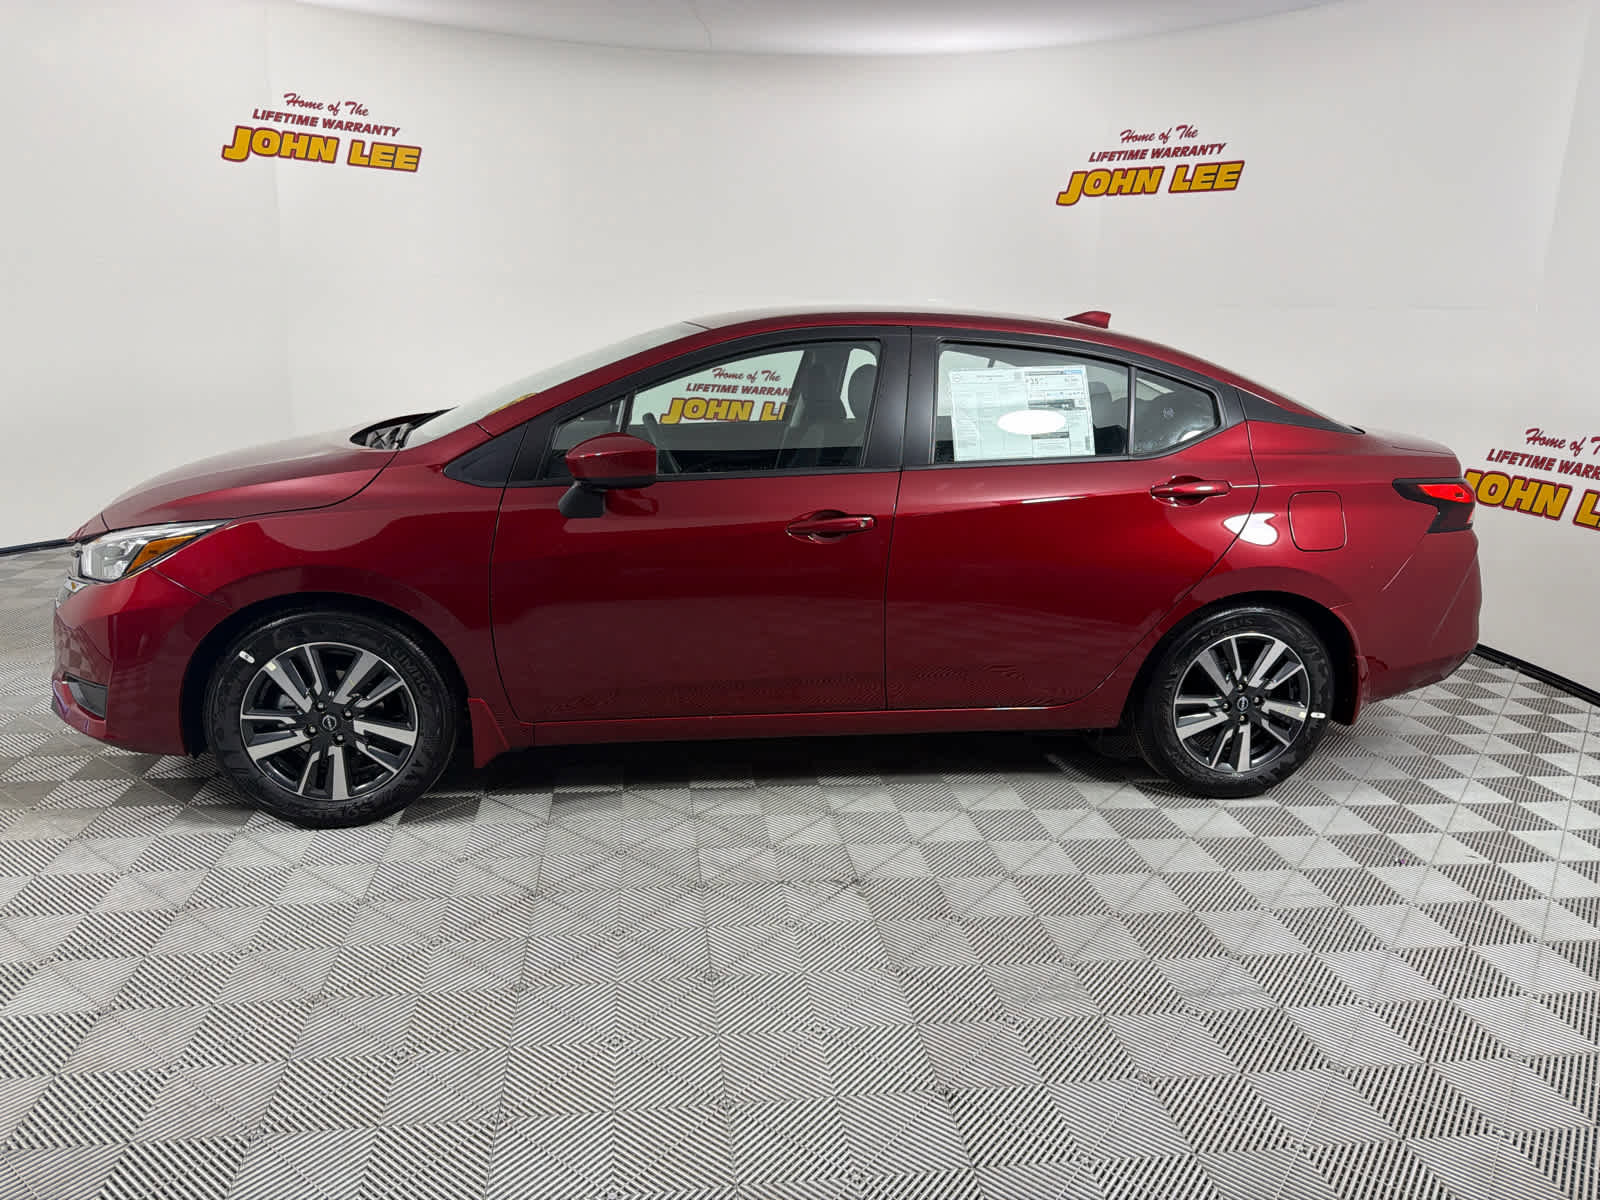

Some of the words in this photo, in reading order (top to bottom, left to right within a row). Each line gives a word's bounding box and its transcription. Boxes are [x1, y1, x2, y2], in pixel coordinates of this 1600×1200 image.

[283, 93, 324, 111] Home
[327, 101, 341, 116] of
[345, 101, 369, 116] The
[252, 108, 320, 127] LIFETIME
[322, 117, 400, 137] WARRANTY
[1119, 129, 1155, 144] Home
[1158, 127, 1173, 144] of
[1175, 124, 1199, 140] The
[221, 125, 340, 163] JOHN
[347, 139, 422, 173] LEE
[1088, 149, 1148, 163] LIFETIME
[1150, 143, 1227, 159] WARRANTY
[1056, 165, 1165, 206] JOHN
[1168, 160, 1245, 194] LEE
[686, 382, 739, 394] LIFETIME
[741, 385, 792, 396] WARRAN
[711, 367, 745, 381] Home
[746, 371, 759, 384] of
[761, 370, 782, 382] The
[659, 397, 754, 424] JOHN
[1525, 427, 1567, 449] Home
[1569, 436, 1587, 457] of
[1486, 448, 1557, 472] LIFETIME
[1557, 459, 1600, 480] WARR
